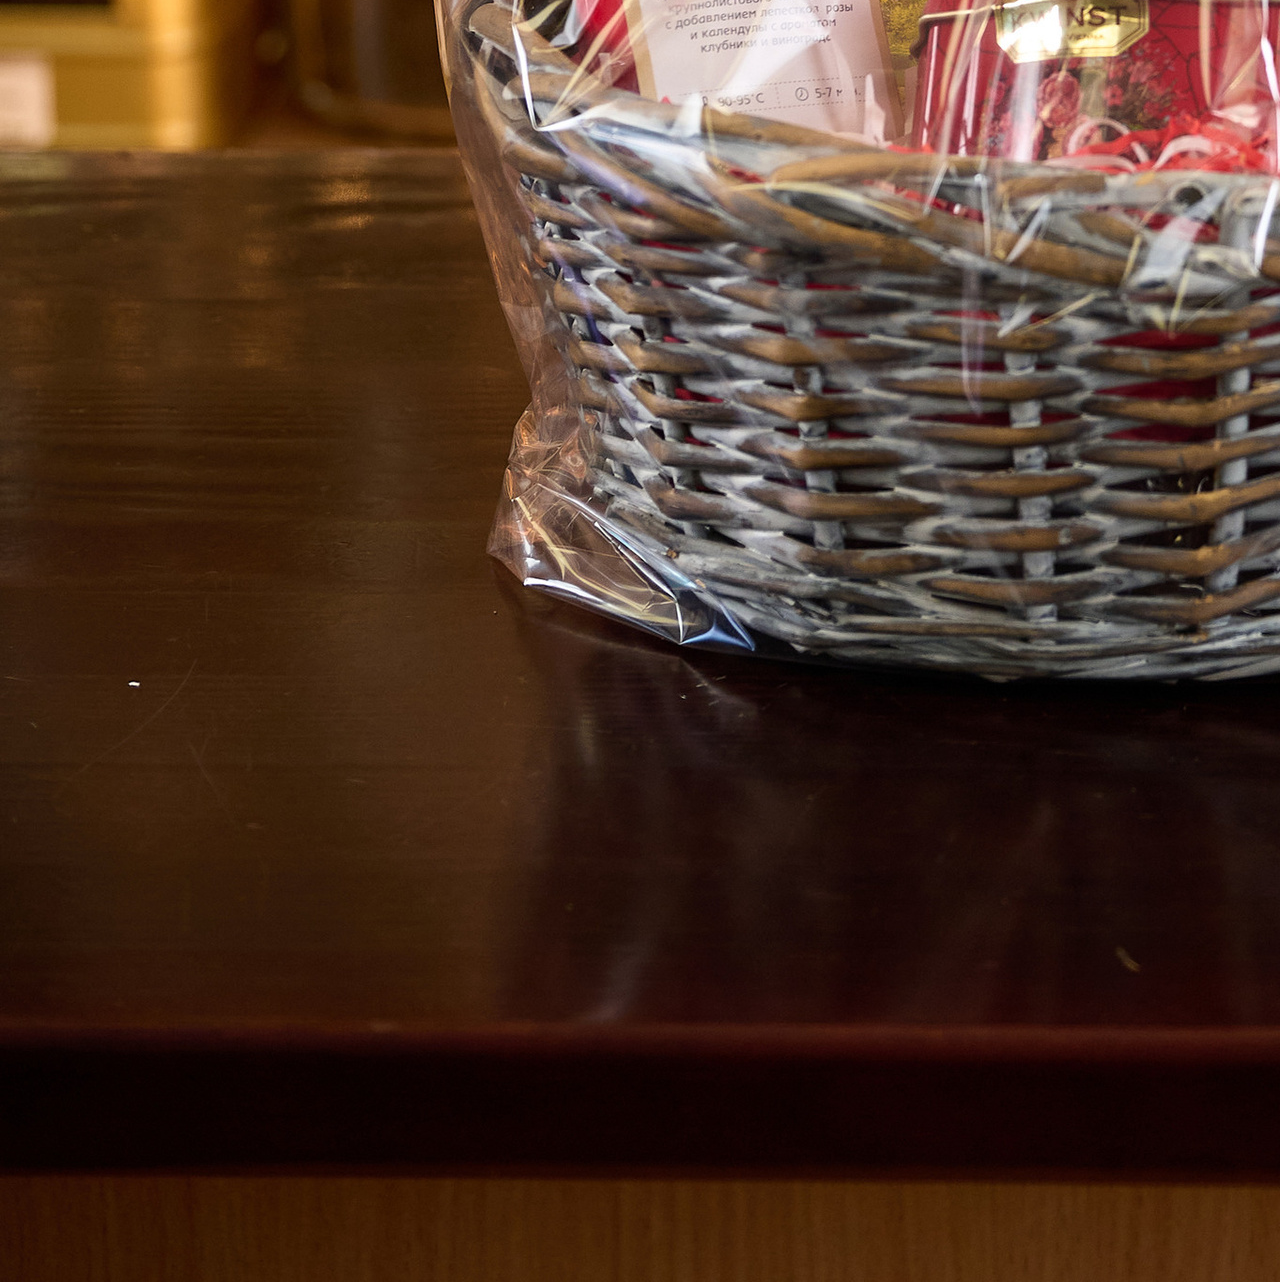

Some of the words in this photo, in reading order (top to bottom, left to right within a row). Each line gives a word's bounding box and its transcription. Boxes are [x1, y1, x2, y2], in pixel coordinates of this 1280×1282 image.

[674, 8, 757, 30] добавлением
[825, 2, 854, 16] розы
[701, 21, 767, 39] календулы
[779, 17, 837, 32] ароатом
[700, 36, 758, 54] клубники
